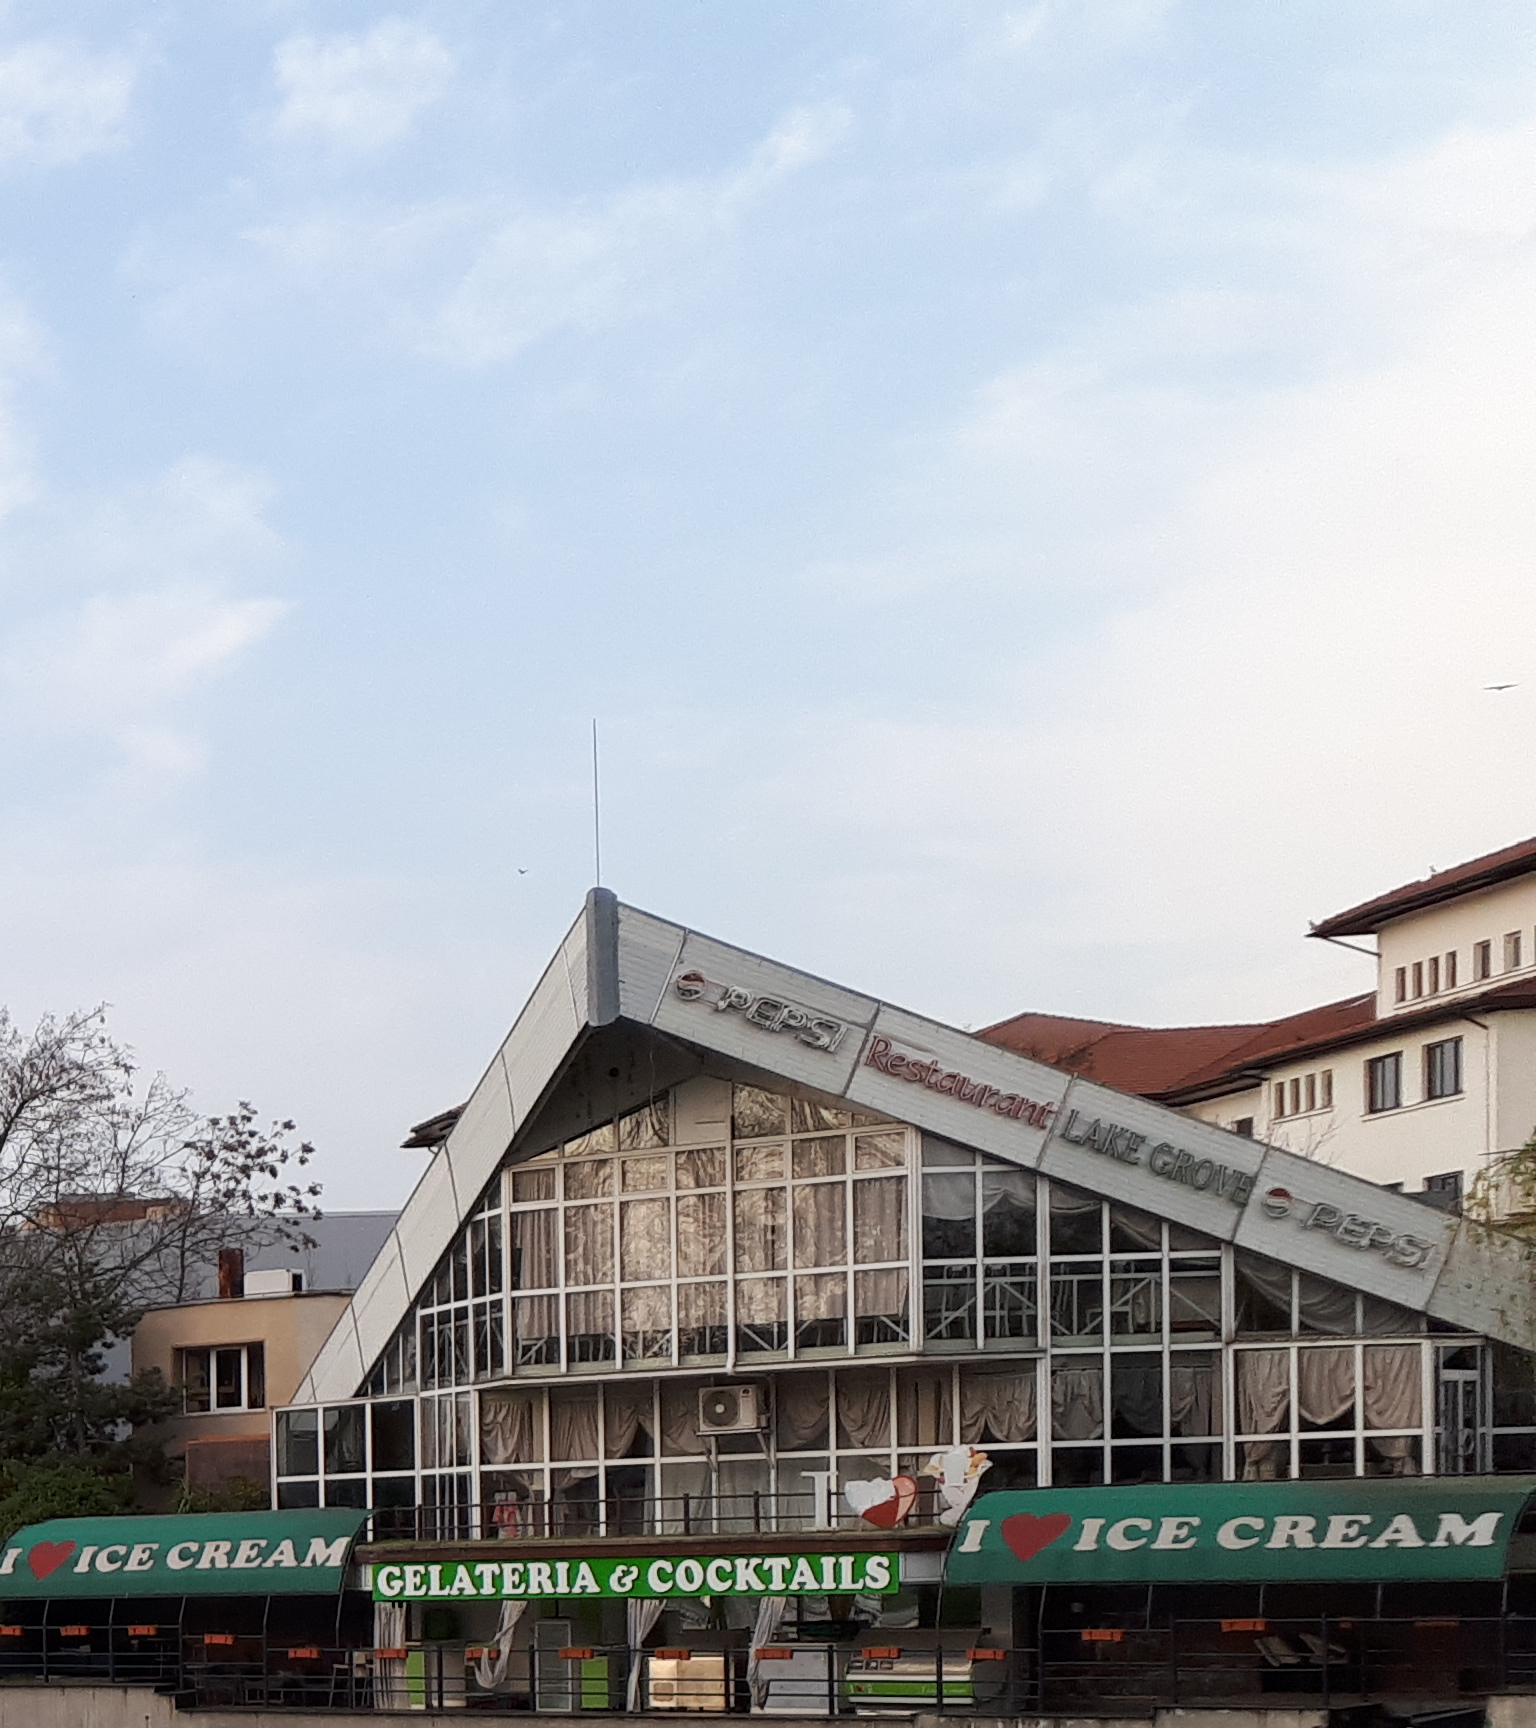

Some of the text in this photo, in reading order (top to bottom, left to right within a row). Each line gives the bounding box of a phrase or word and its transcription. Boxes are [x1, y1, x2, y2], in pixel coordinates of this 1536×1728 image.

[716, 985, 849, 1053] PEPSI
[864, 1035, 1057, 1129] Restaurant
[1059, 1109, 1257, 1207] LAKE GROVE
[1304, 1203, 1439, 1271] PEPSI
[73, 1542, 159, 1574] ICE
[166, 1536, 352, 1570] CREAM
[958, 1512, 1504, 1552] I ICE CREAM
[377, 1555, 891, 1597] GELATERIA & COCKTAILS
